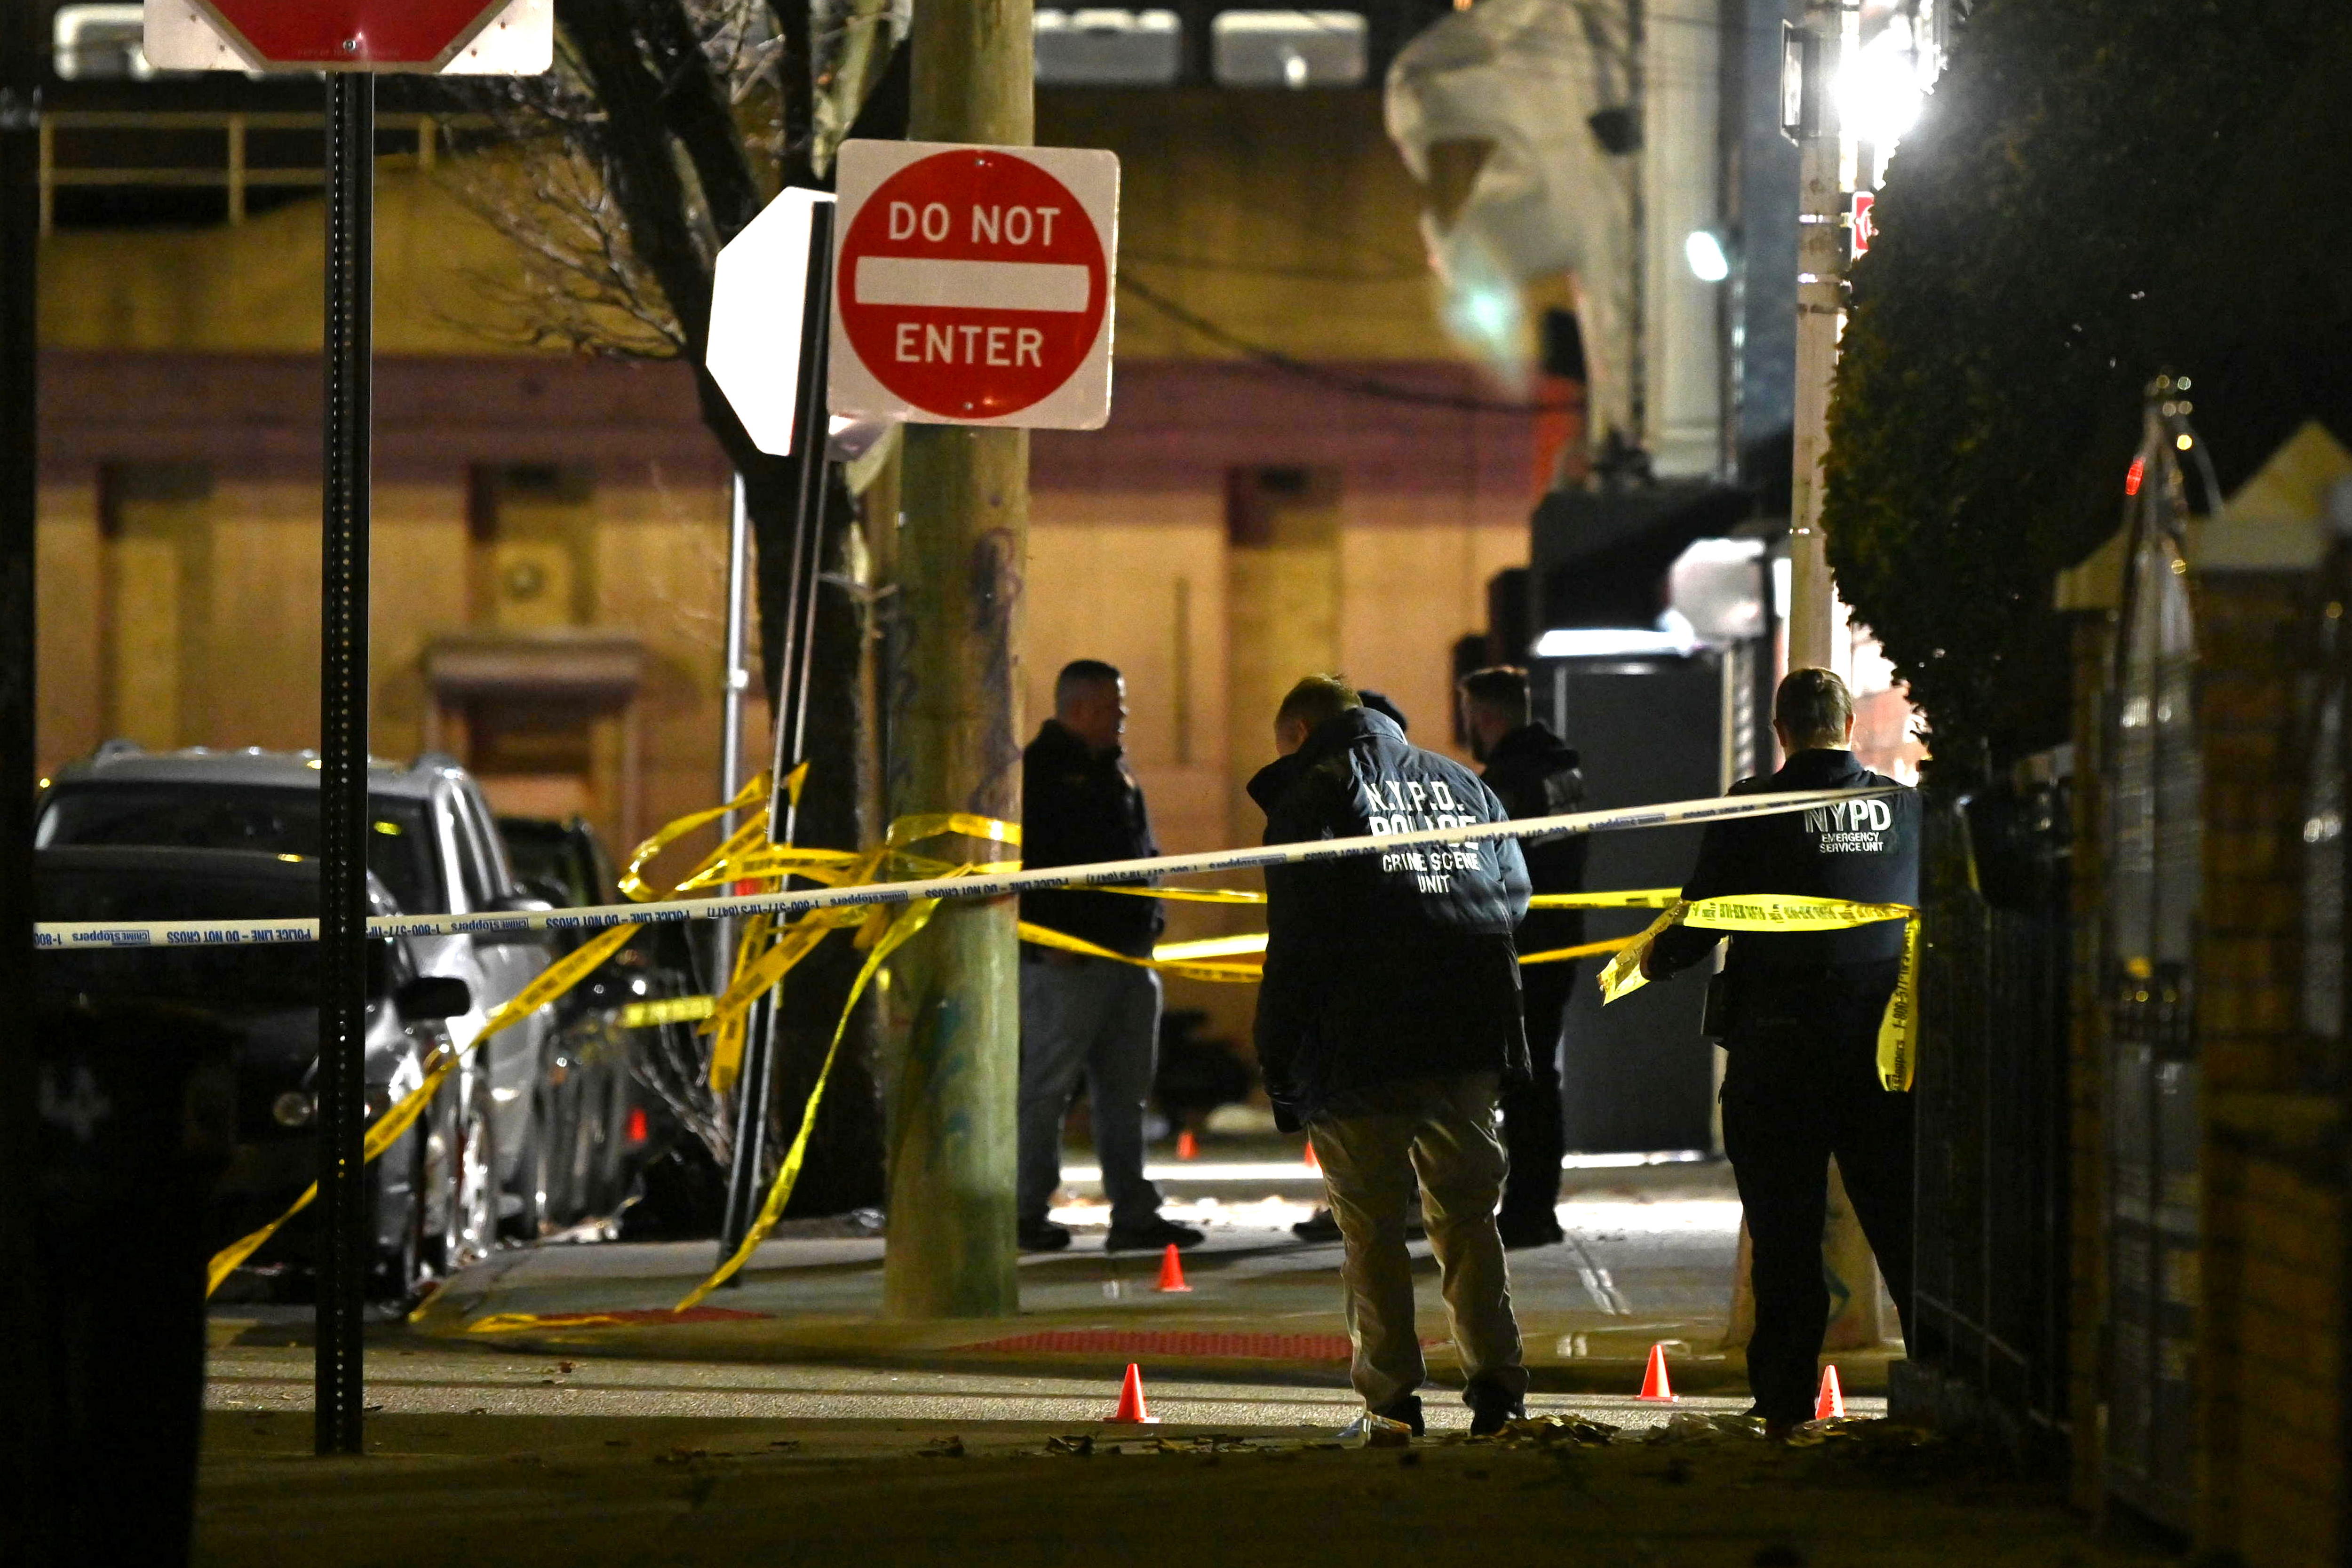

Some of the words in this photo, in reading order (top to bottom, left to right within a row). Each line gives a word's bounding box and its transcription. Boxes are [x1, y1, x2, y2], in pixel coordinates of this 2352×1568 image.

[889, 201, 951, 242] DO
[970, 204, 1061, 247] NOT
[895, 322, 1045, 368] ENTER
[1363, 781, 1465, 813] N.Y.P.D.
[1804, 799, 1892, 834] NYPD
[1820, 832, 1880, 844] EMERGENCY
[1820, 843, 1860, 853] SERVICE
[1861, 841, 1884, 852] UNIT
[1382, 852, 1427, 873] CRIME
[1431, 852, 1480, 872] SCENE
[1417, 874, 1451, 894] UNIT
[546, 916, 580, 929] CROSS
[583, 915, 602, 927] NOT
[604, 915, 618, 926] DO
[167, 931, 201, 944] CROSS
[204, 931, 222, 943] NOT
[225, 931, 239, 943] DO
[251, 929, 273, 942] LINE
[276, 928, 311, 942] POLICE
